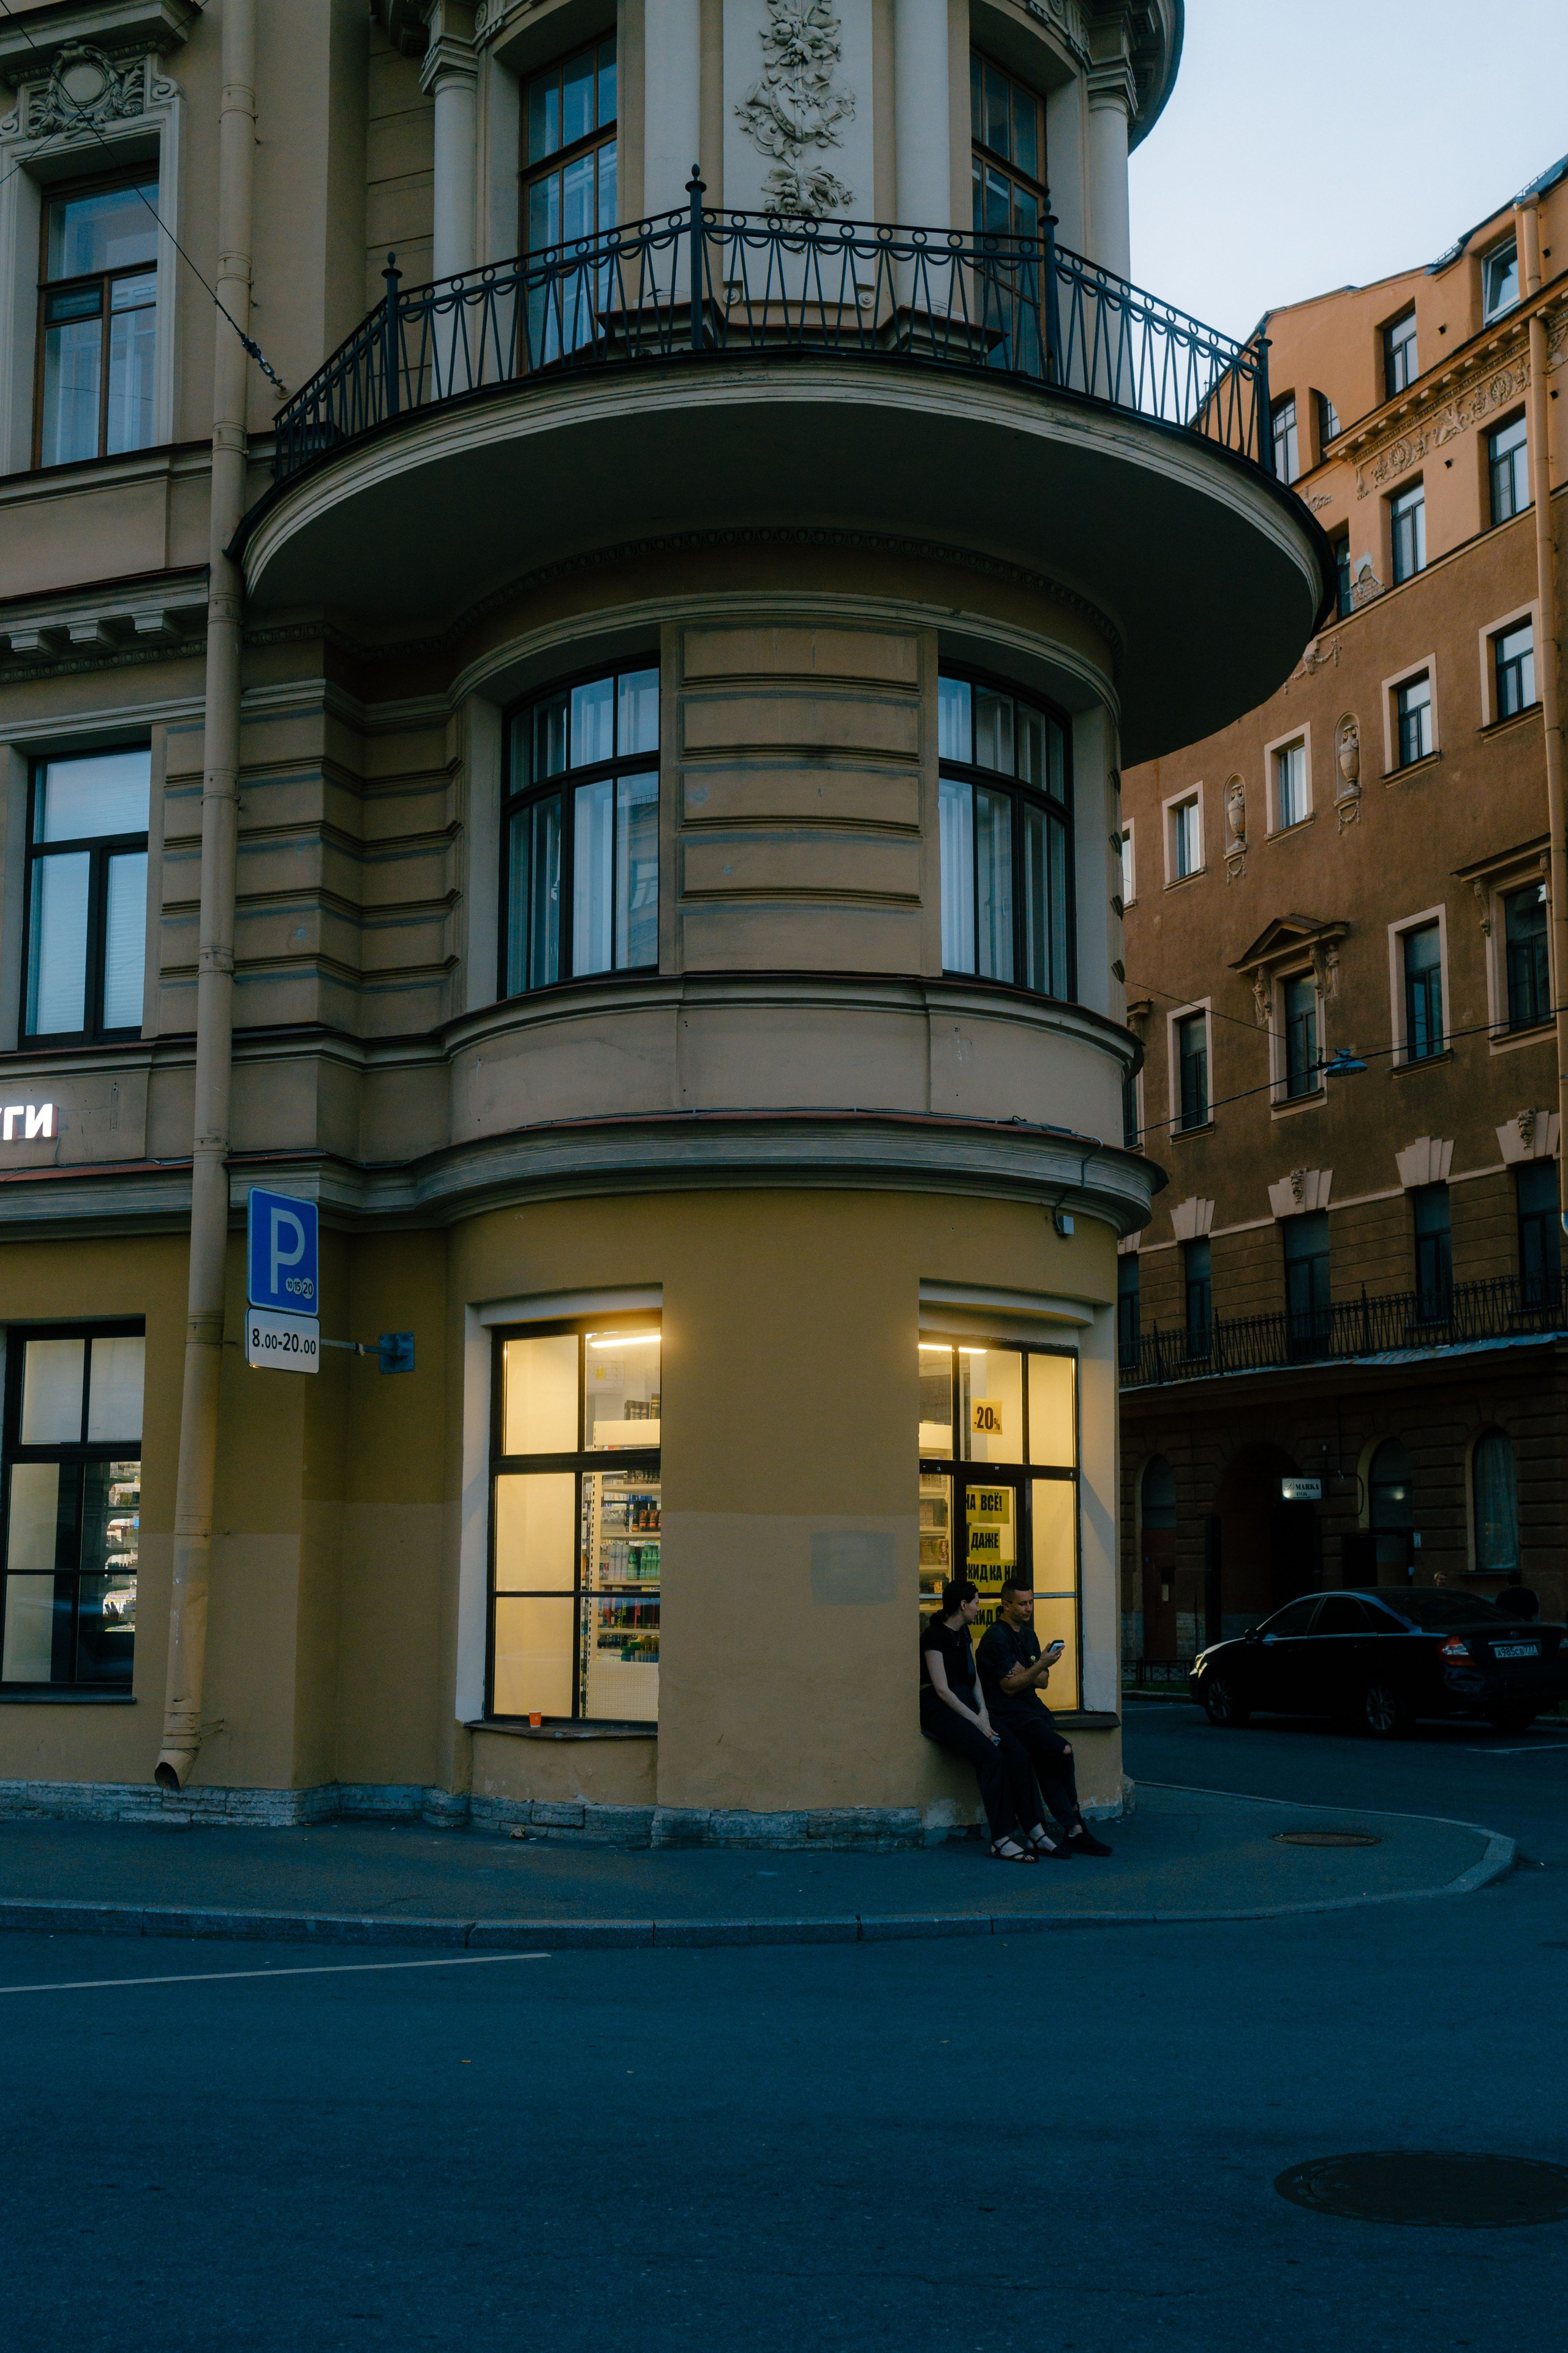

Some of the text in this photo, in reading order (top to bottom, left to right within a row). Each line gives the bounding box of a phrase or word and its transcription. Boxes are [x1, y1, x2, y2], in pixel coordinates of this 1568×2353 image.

[0, 1103, 53, 1141] ГИ
[271, 1207, 305, 1294] P
[287, 1280, 313, 1296] 10 15 20
[974, 1406, 1000, 1430] -20%
[981, 1492, 1002, 1511] ВСЁ!
[971, 1532, 999, 1551] ДАЖЕ
